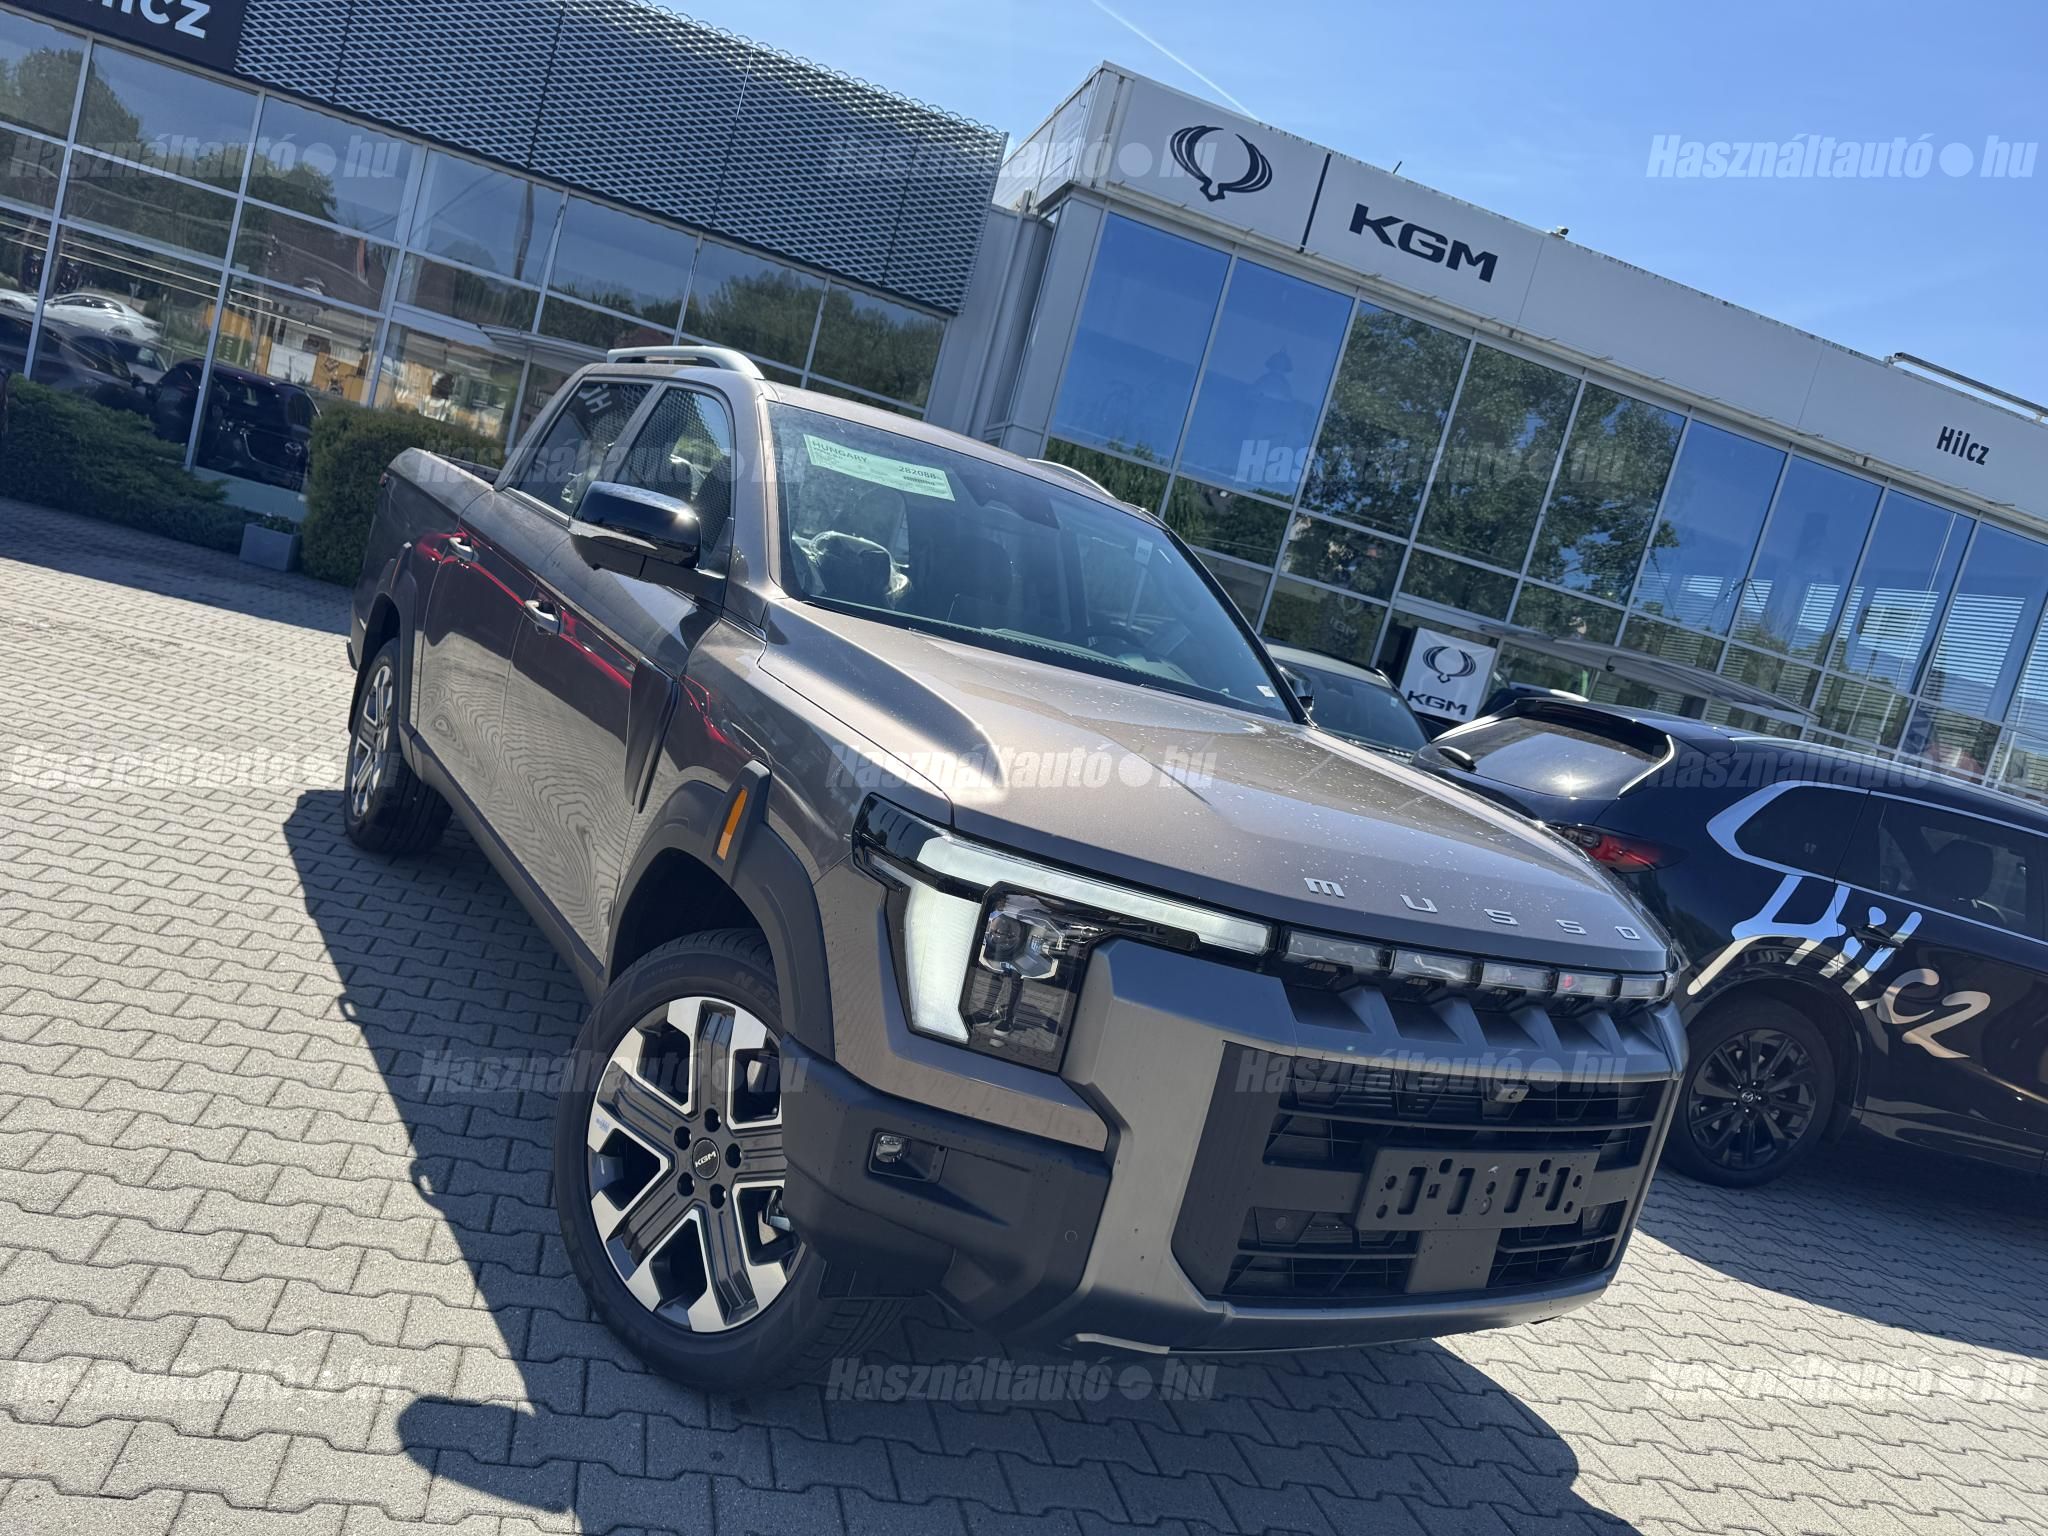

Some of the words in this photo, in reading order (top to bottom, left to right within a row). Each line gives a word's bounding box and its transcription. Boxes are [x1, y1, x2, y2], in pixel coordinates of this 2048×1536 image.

[1349, 203, 1498, 283] KGM
[812, 441, 868, 463] HUNGARY
[1936, 426, 1990, 465] Hilcz
[1407, 690, 1468, 715] KGM
[1304, 877, 1640, 940] MUSSO
[694, 1151, 717, 1168] KGM
